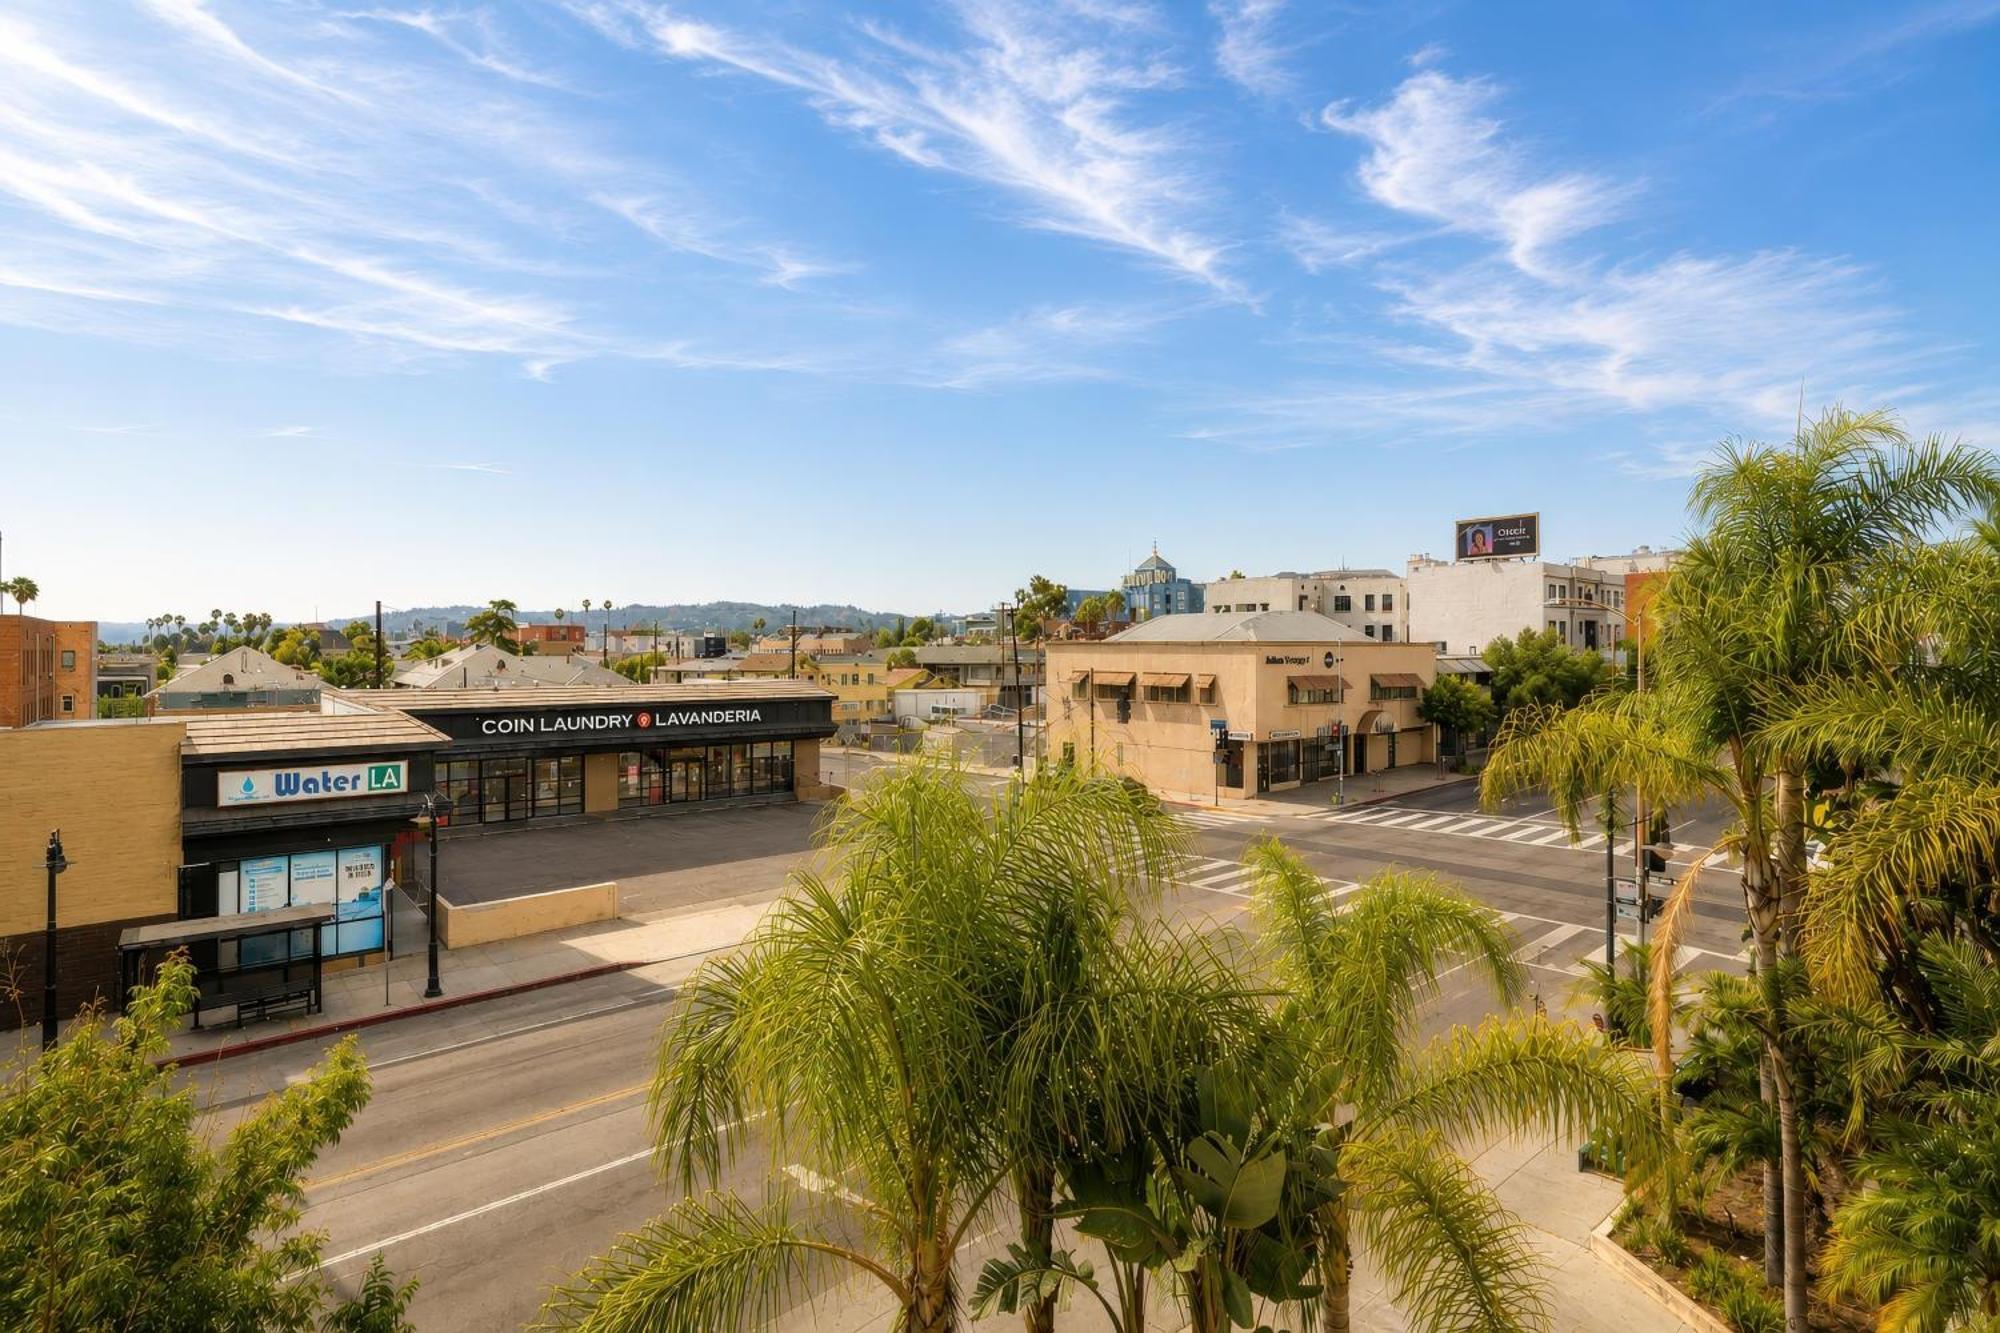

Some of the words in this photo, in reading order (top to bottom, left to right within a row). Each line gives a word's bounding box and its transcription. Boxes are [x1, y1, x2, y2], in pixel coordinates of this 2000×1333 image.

[482, 718, 534, 735] COIN
[540, 714, 633, 732] LAUNDRY
[655, 709, 761, 727] LAVANDERIA
[275, 770, 361, 797] Water
[371, 768, 398, 789] LA
